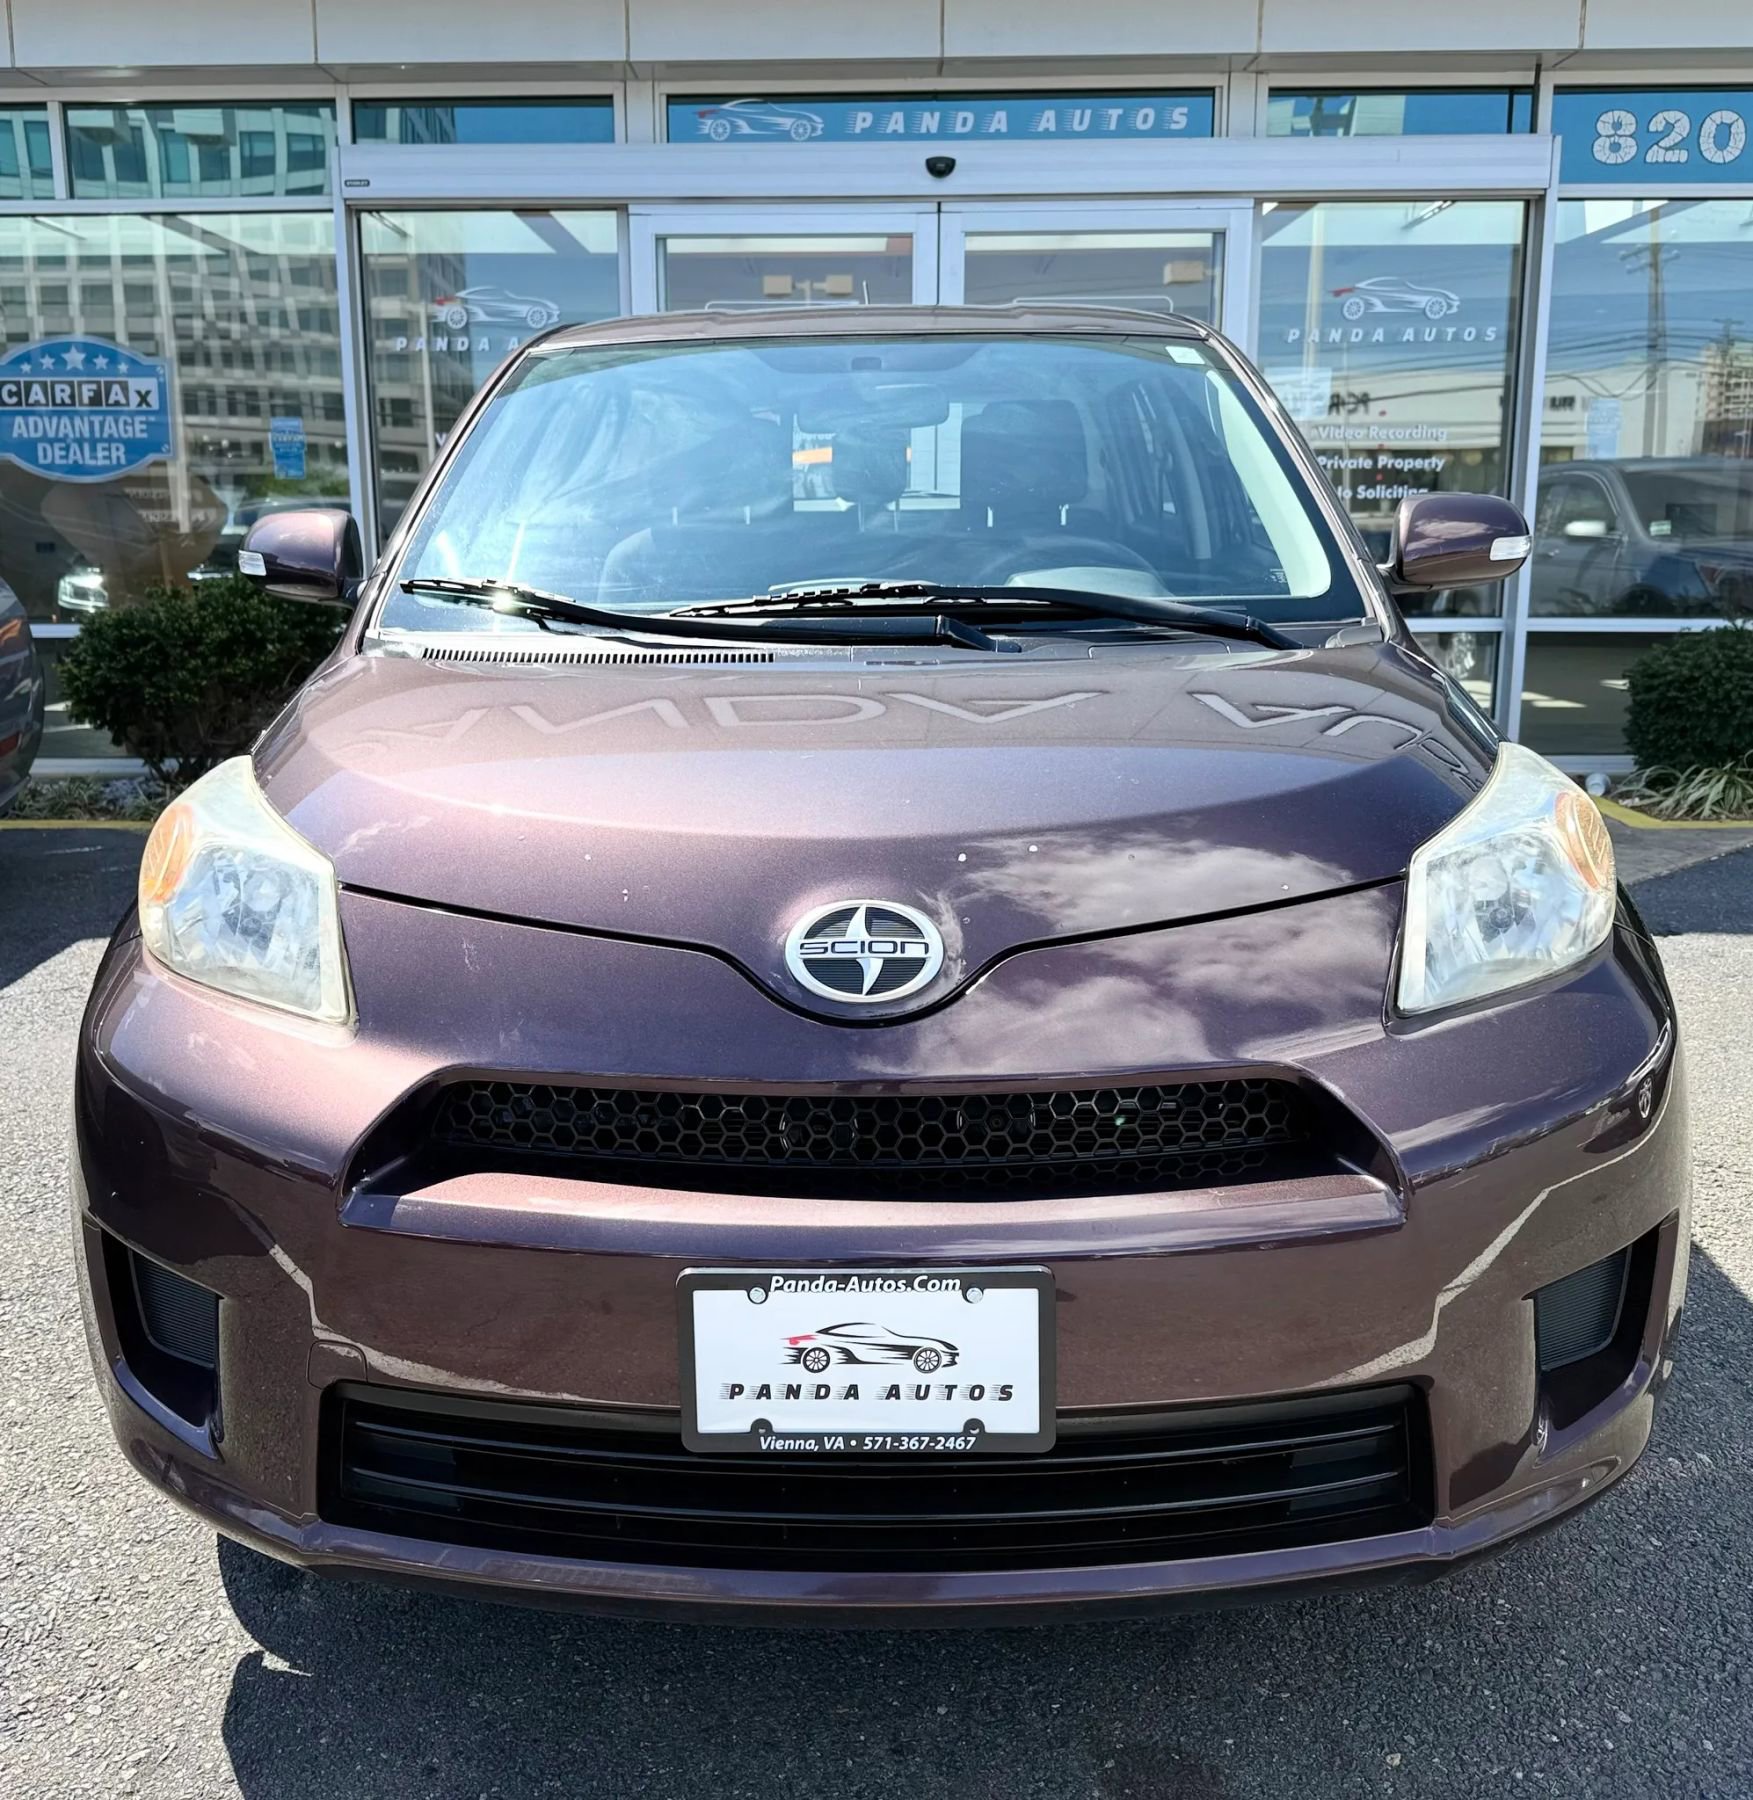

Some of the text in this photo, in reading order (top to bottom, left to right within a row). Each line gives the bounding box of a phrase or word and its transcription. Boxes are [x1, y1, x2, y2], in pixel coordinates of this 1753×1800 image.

[848, 106, 1188, 134] PANDA AUTOS
[1592, 108, 1747, 165] 820
[396, 336, 490, 351] PANDA
[1287, 326, 1497, 343] PANDA AUTOS
[1, 383, 153, 408] CARFAX
[12, 415, 148, 438] ADVANTAGE
[1318, 425, 1447, 441] Video Recording
[37, 442, 126, 465] DEALER
[1317, 455, 1445, 473] Private Property
[800, 940, 930, 955] SCION
[769, 1275, 961, 1293] Panda-Autos.Com
[721, 1383, 1014, 1401] PANDA AUTOS
[760, 1437, 976, 1452] Vienna, VA 571-367-2467
